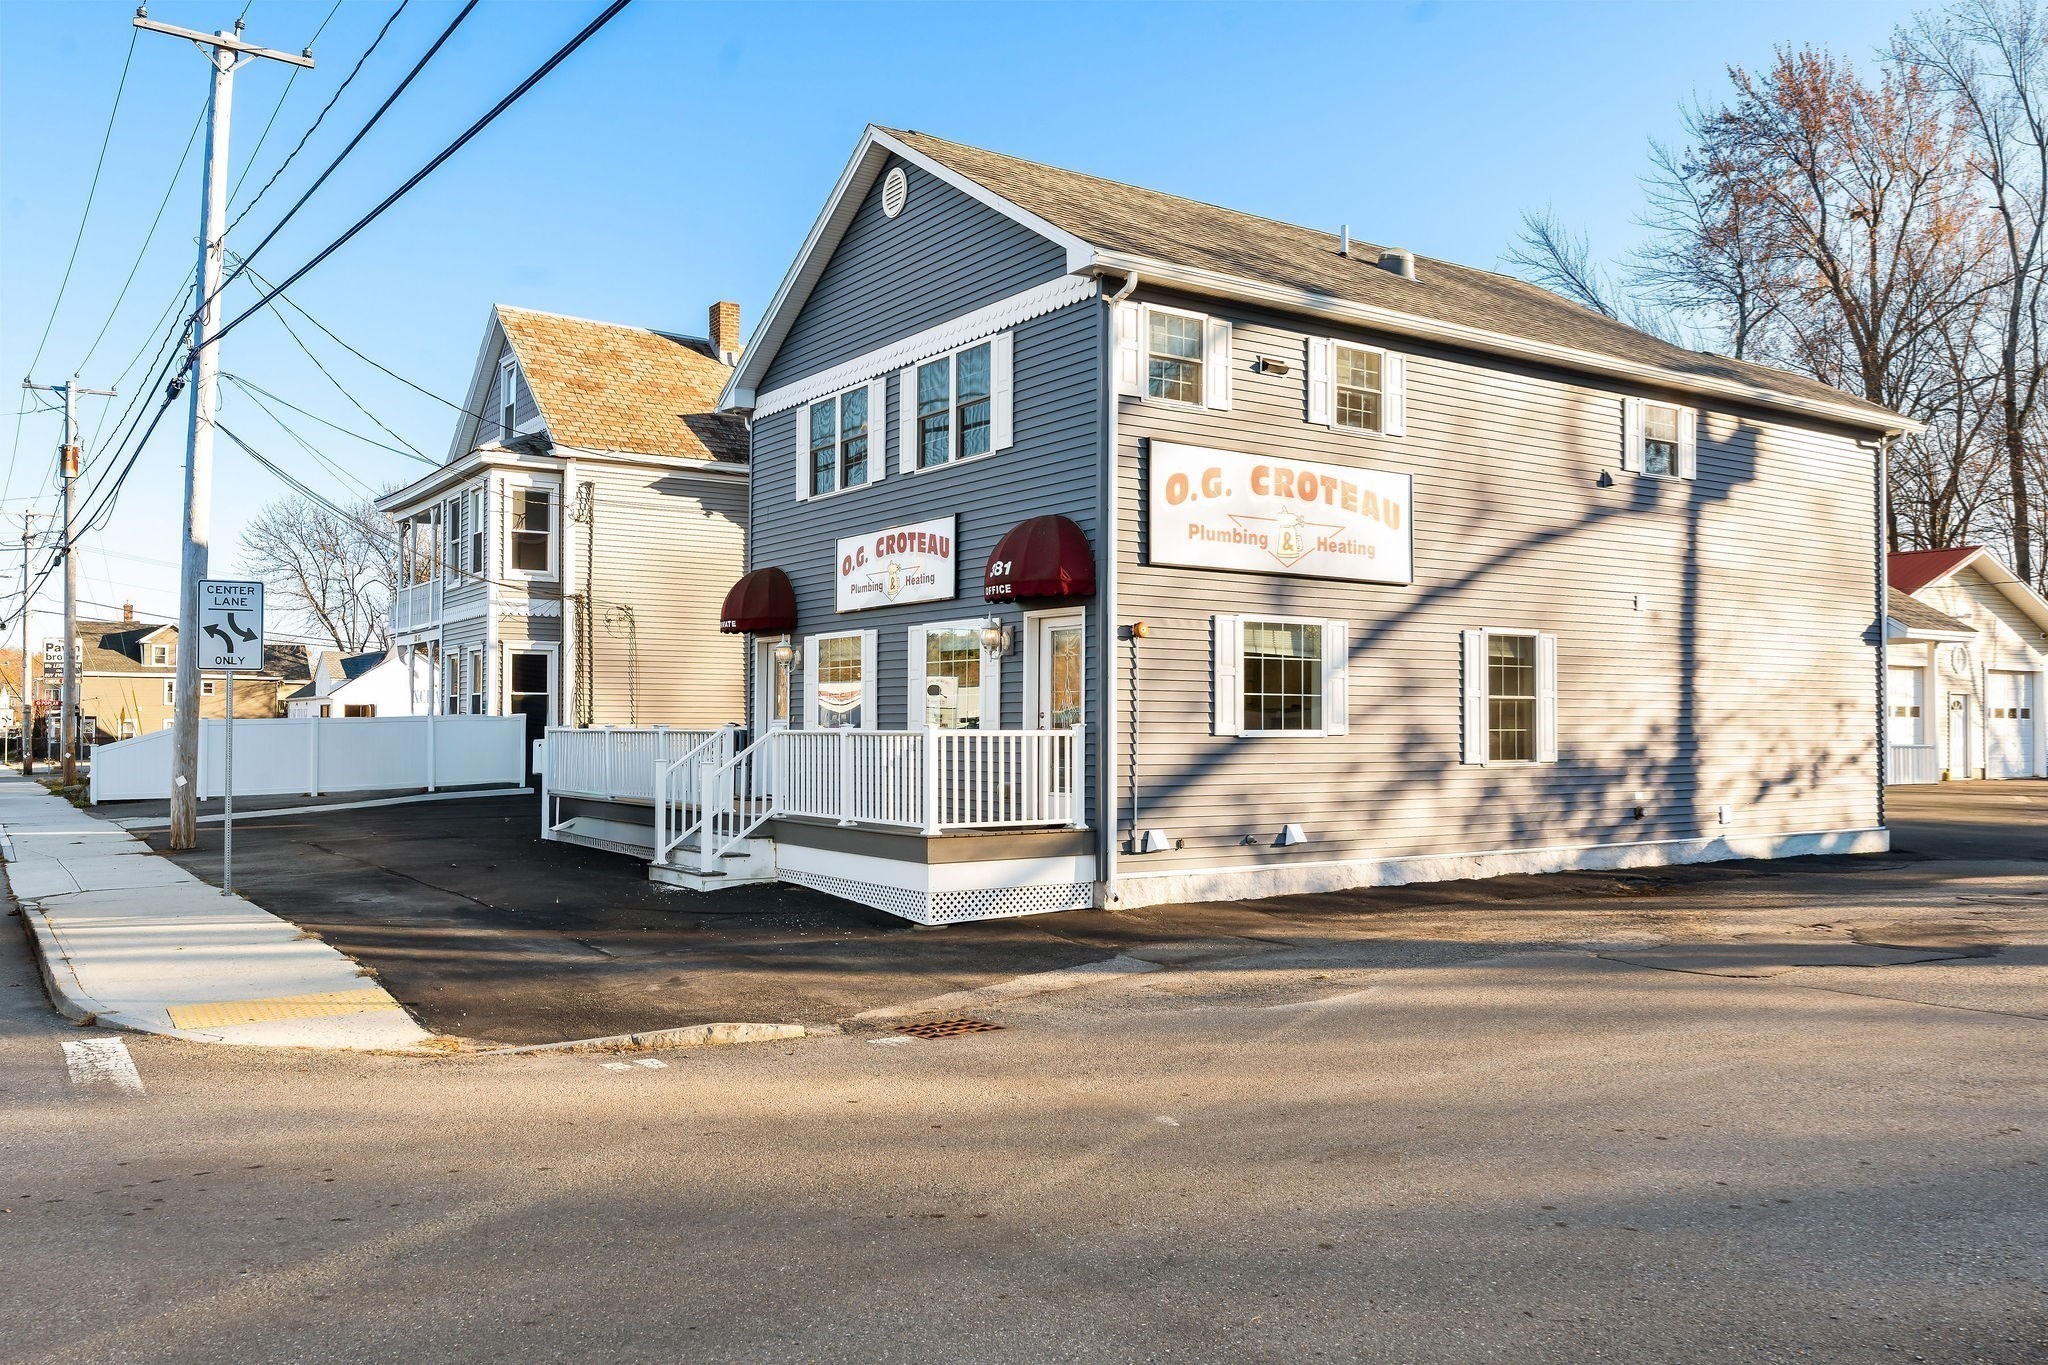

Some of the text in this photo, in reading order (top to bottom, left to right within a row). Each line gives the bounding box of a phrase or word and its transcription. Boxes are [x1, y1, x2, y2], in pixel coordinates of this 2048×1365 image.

[1165, 464, 1400, 531] O.G. CROTEAU
[1188, 523, 1376, 560] Plumbing & Heating
[842, 532, 950, 577] O.G. CROTEAU
[850, 572, 935, 595] Plumbing & Heating
[206, 585, 255, 596] CENTER
[985, 584, 1012, 596] OFFICE
[214, 597, 248, 607] LANE
[46, 653, 81, 661] bror
[215, 656, 246, 665] ONLY
